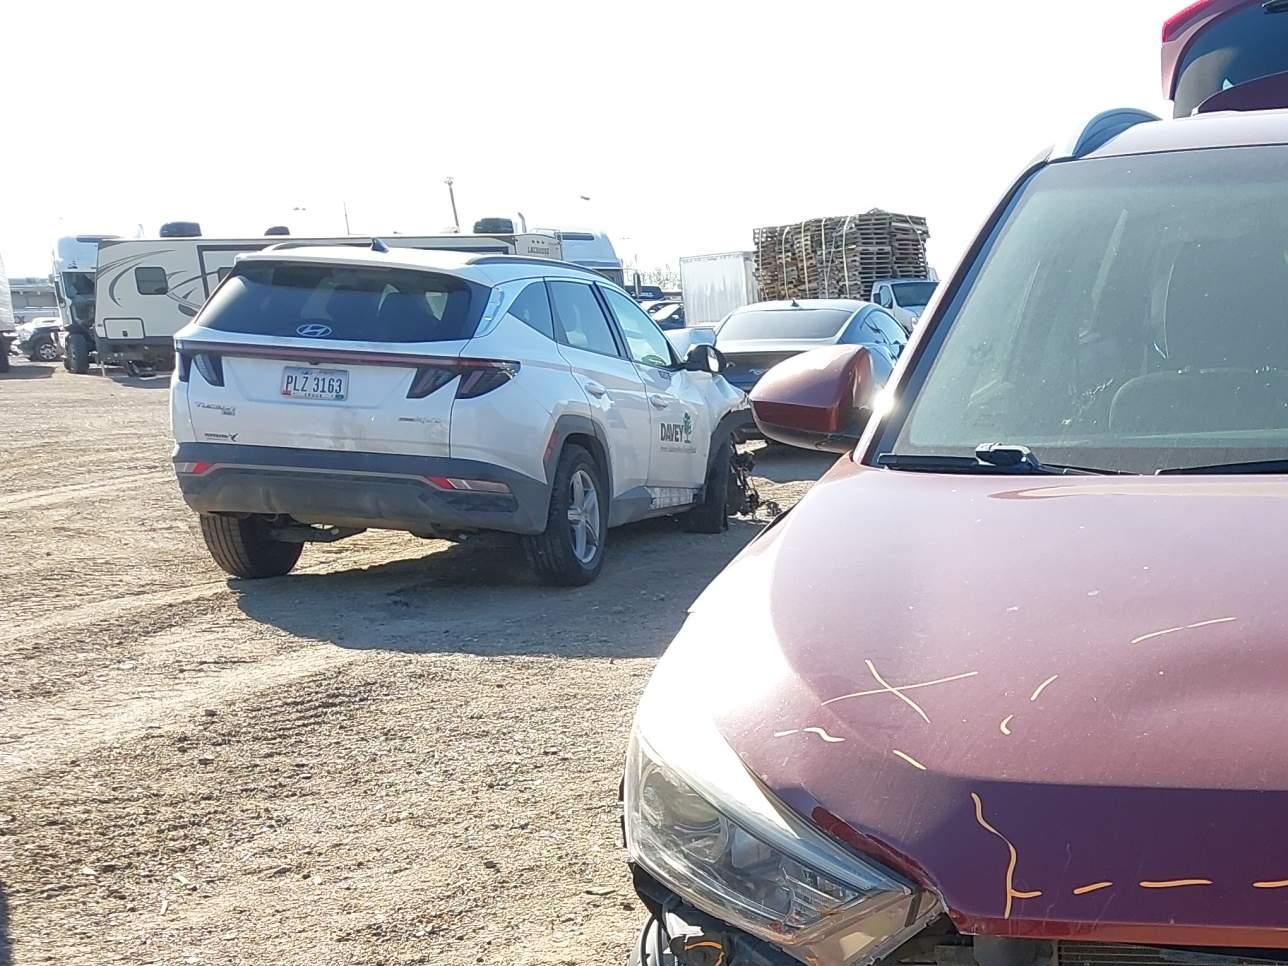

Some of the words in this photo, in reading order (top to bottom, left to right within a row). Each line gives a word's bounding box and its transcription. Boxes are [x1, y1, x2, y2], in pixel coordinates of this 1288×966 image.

[286, 375, 309, 392] PLZ
[313, 377, 343, 394] 3163
[660, 422, 684, 443] DAVEY
